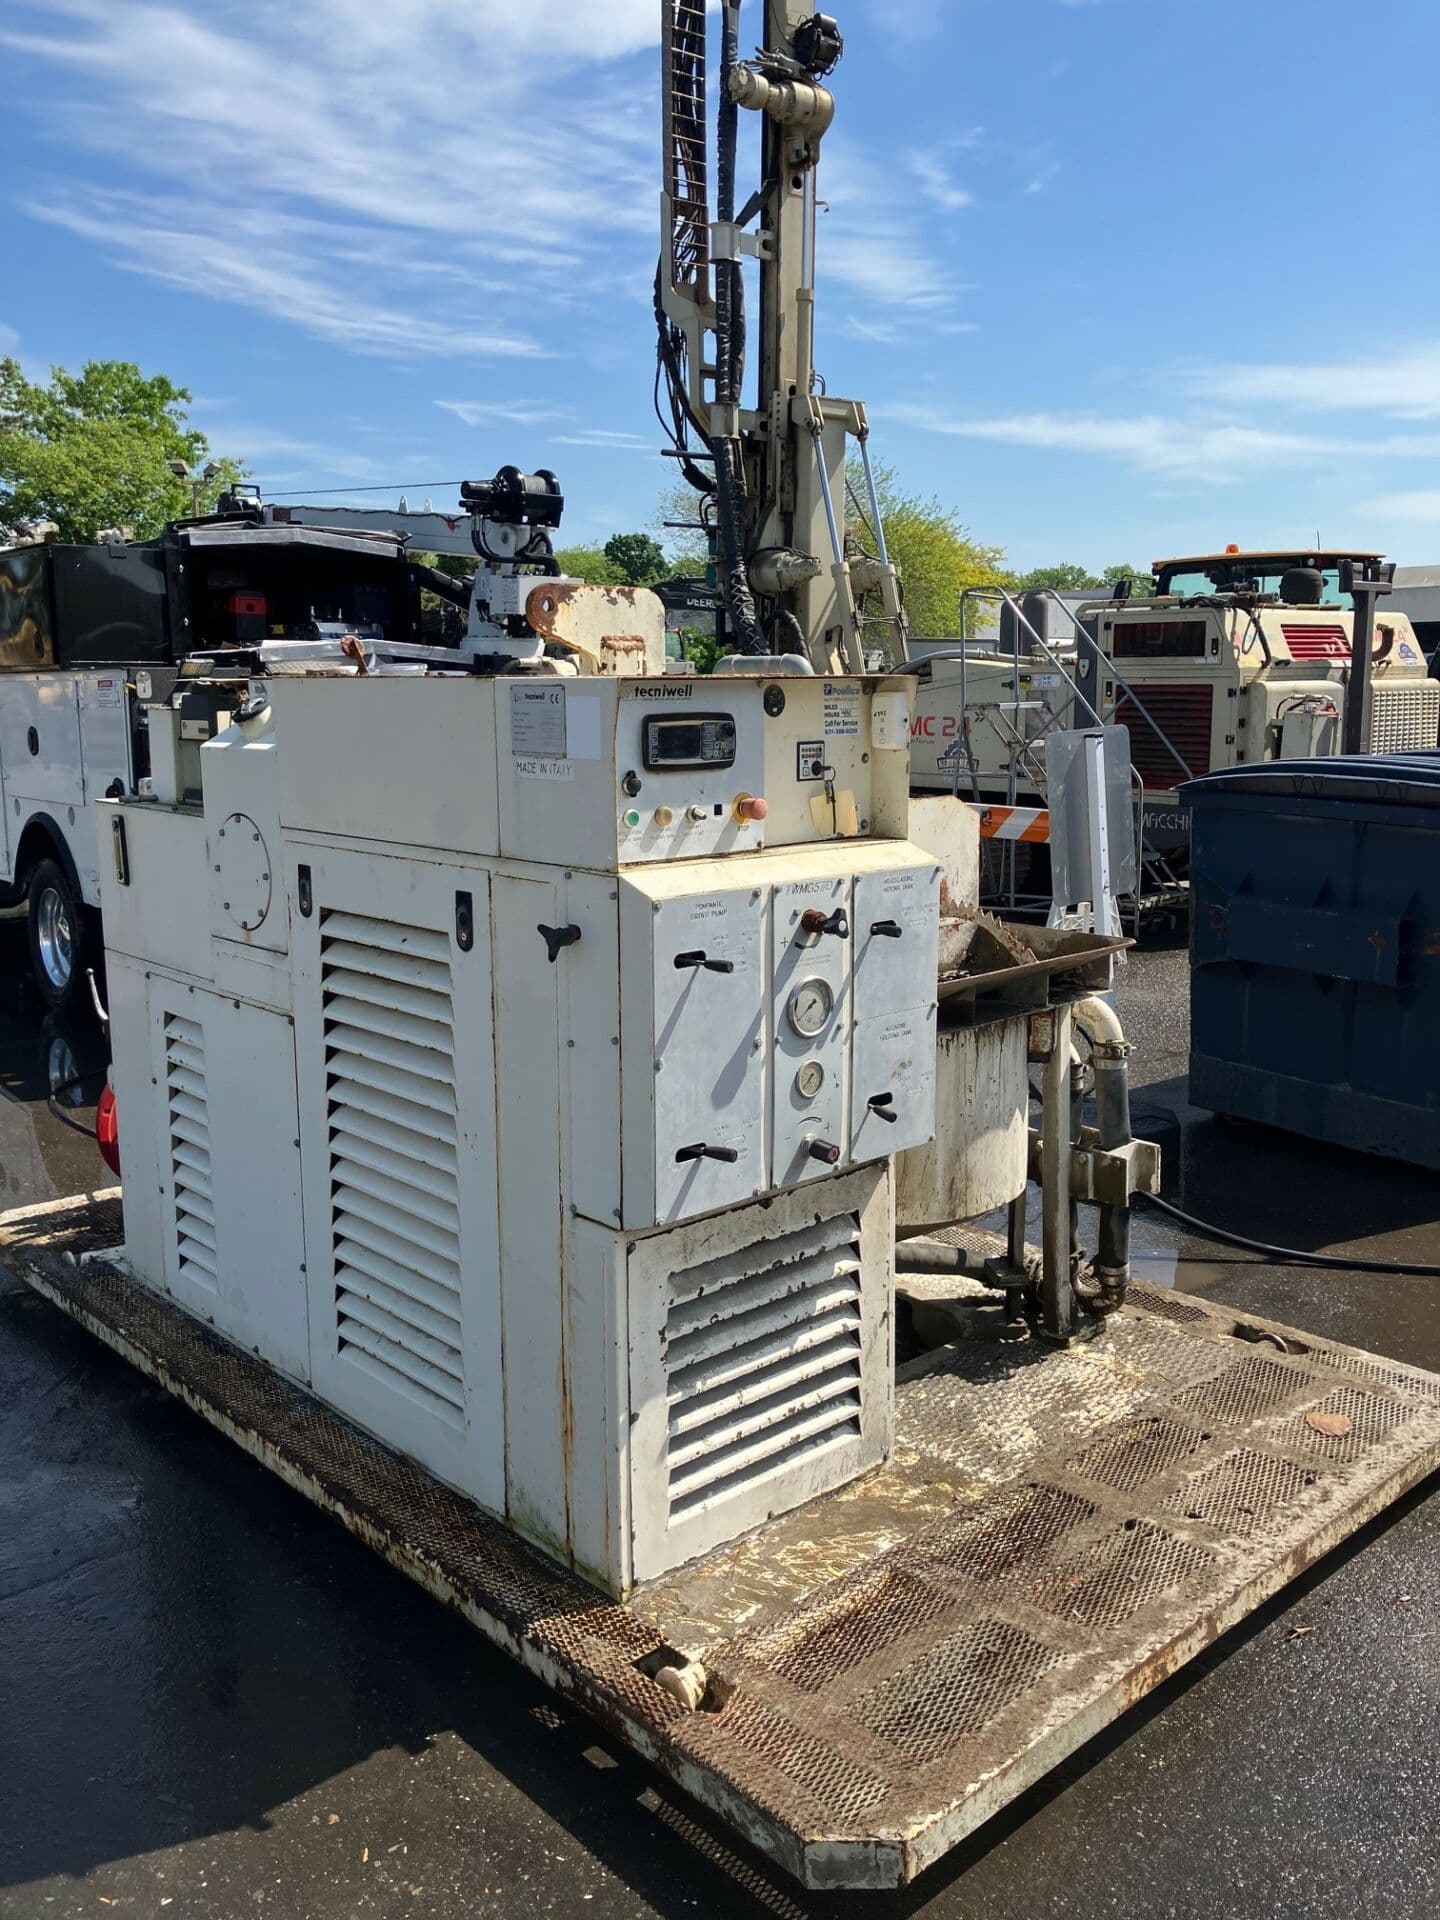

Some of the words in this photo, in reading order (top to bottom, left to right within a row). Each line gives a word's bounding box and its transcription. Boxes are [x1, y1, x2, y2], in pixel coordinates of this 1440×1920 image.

[634, 685, 692, 697] tecniwell
[517, 762, 536, 774] MADE
[540, 763, 547, 774] IN
